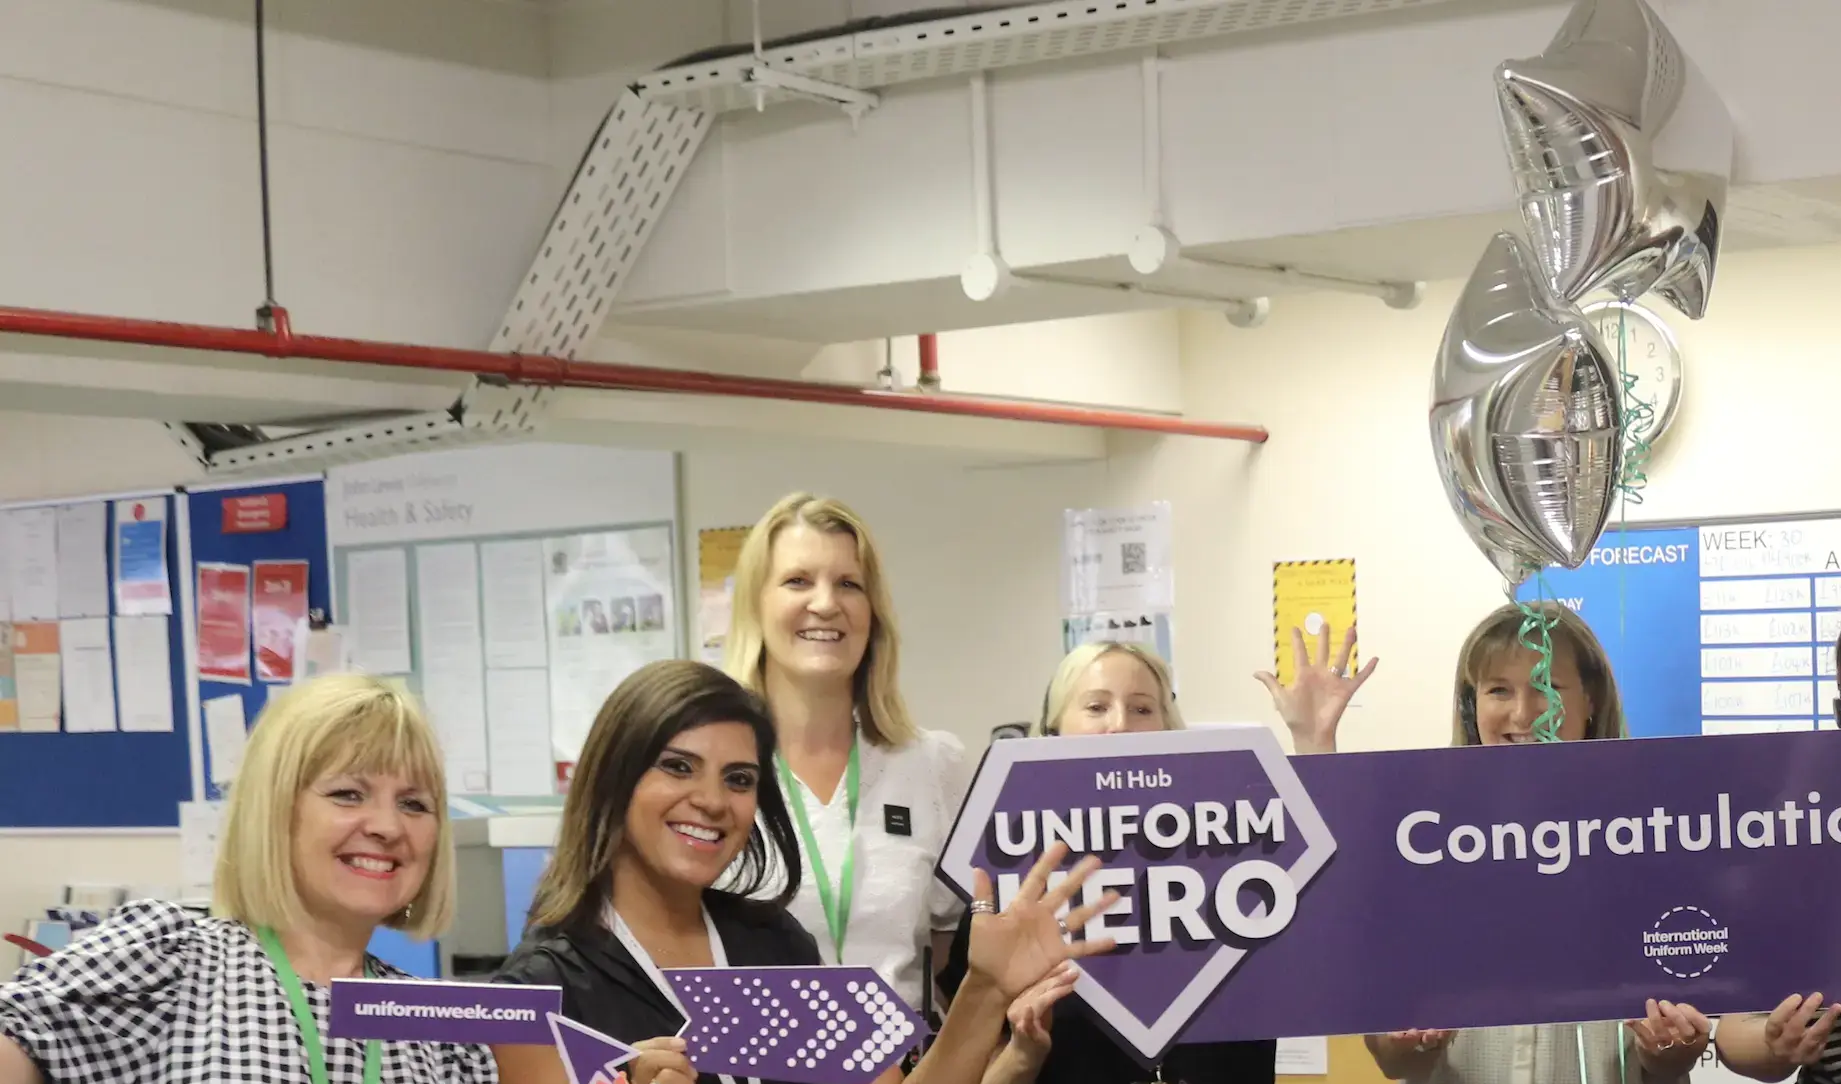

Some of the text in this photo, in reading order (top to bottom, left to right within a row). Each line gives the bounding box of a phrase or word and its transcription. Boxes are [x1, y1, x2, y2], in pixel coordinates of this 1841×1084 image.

[1646, 342, 1658, 359] 2
[1655, 366, 1665, 383] 3
[344, 498, 474, 529] Health & Safety
[1702, 529, 1773, 551] WEEK:
[1590, 543, 1689, 567] FORECAST
[1094, 768, 1173, 791] Mi Hub
[994, 797, 1286, 857] UNIFORM
[1643, 927, 1729, 944] International
[1644, 940, 1728, 957] Uniform Week
[354, 1000, 537, 1022] uniformweek.com
